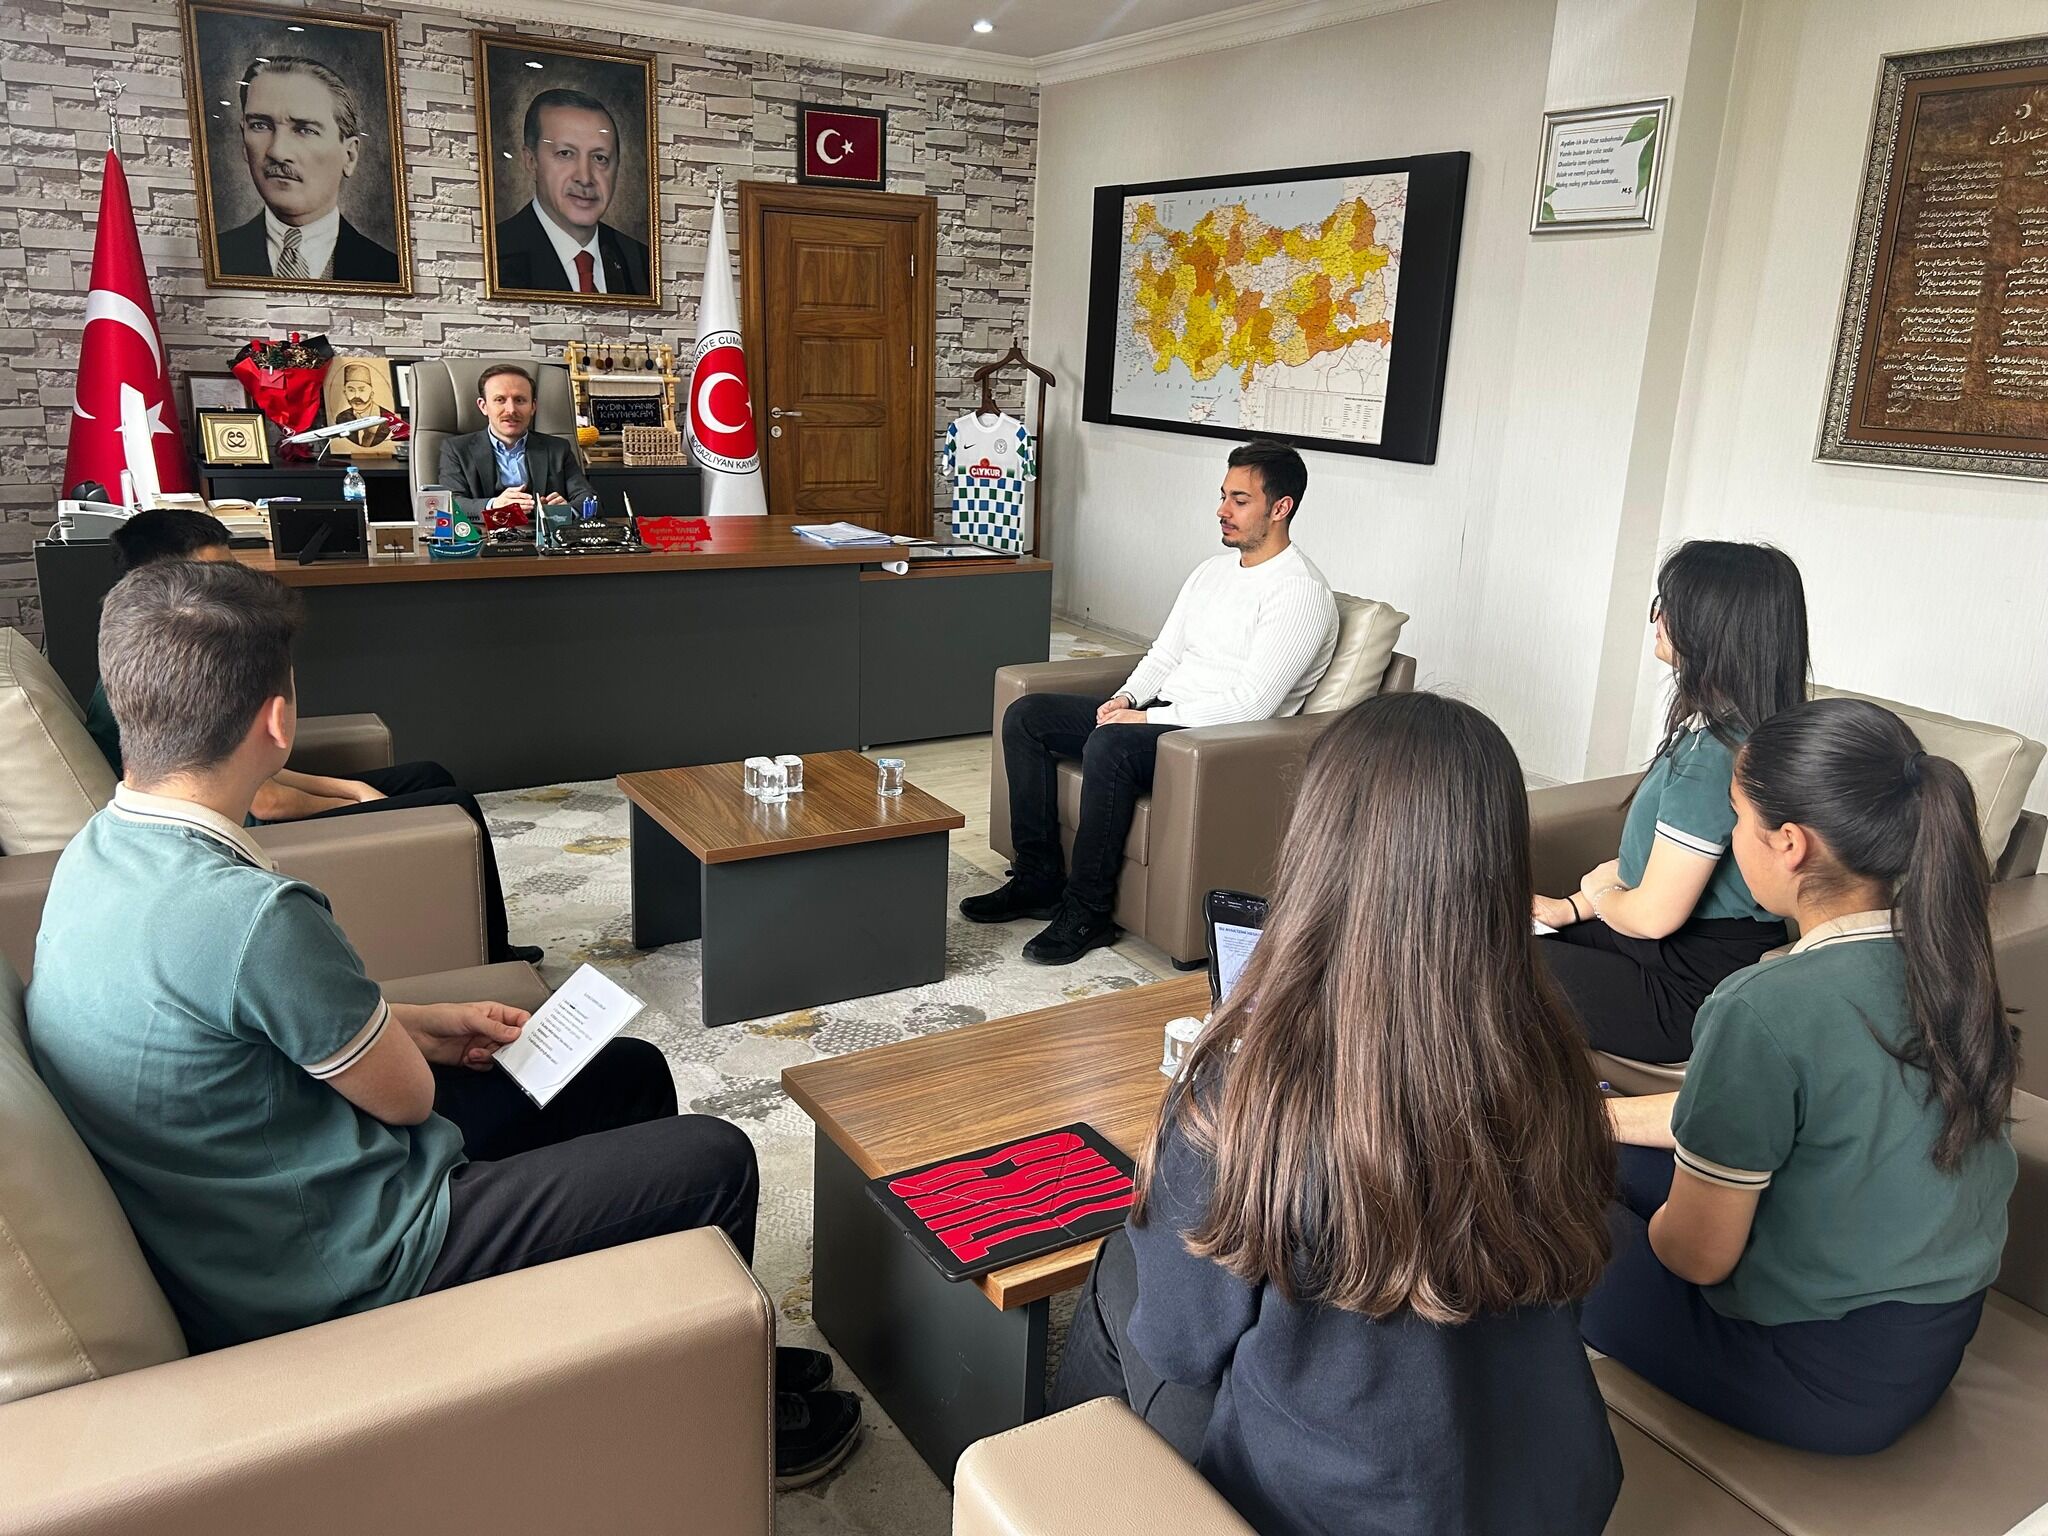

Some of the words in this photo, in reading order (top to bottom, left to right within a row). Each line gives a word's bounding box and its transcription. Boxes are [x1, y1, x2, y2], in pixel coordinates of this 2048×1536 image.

[597, 403, 626, 411] AYDIN
[629, 402, 656, 410] YANIK
[600, 410, 654, 419] KAYMAKAM
